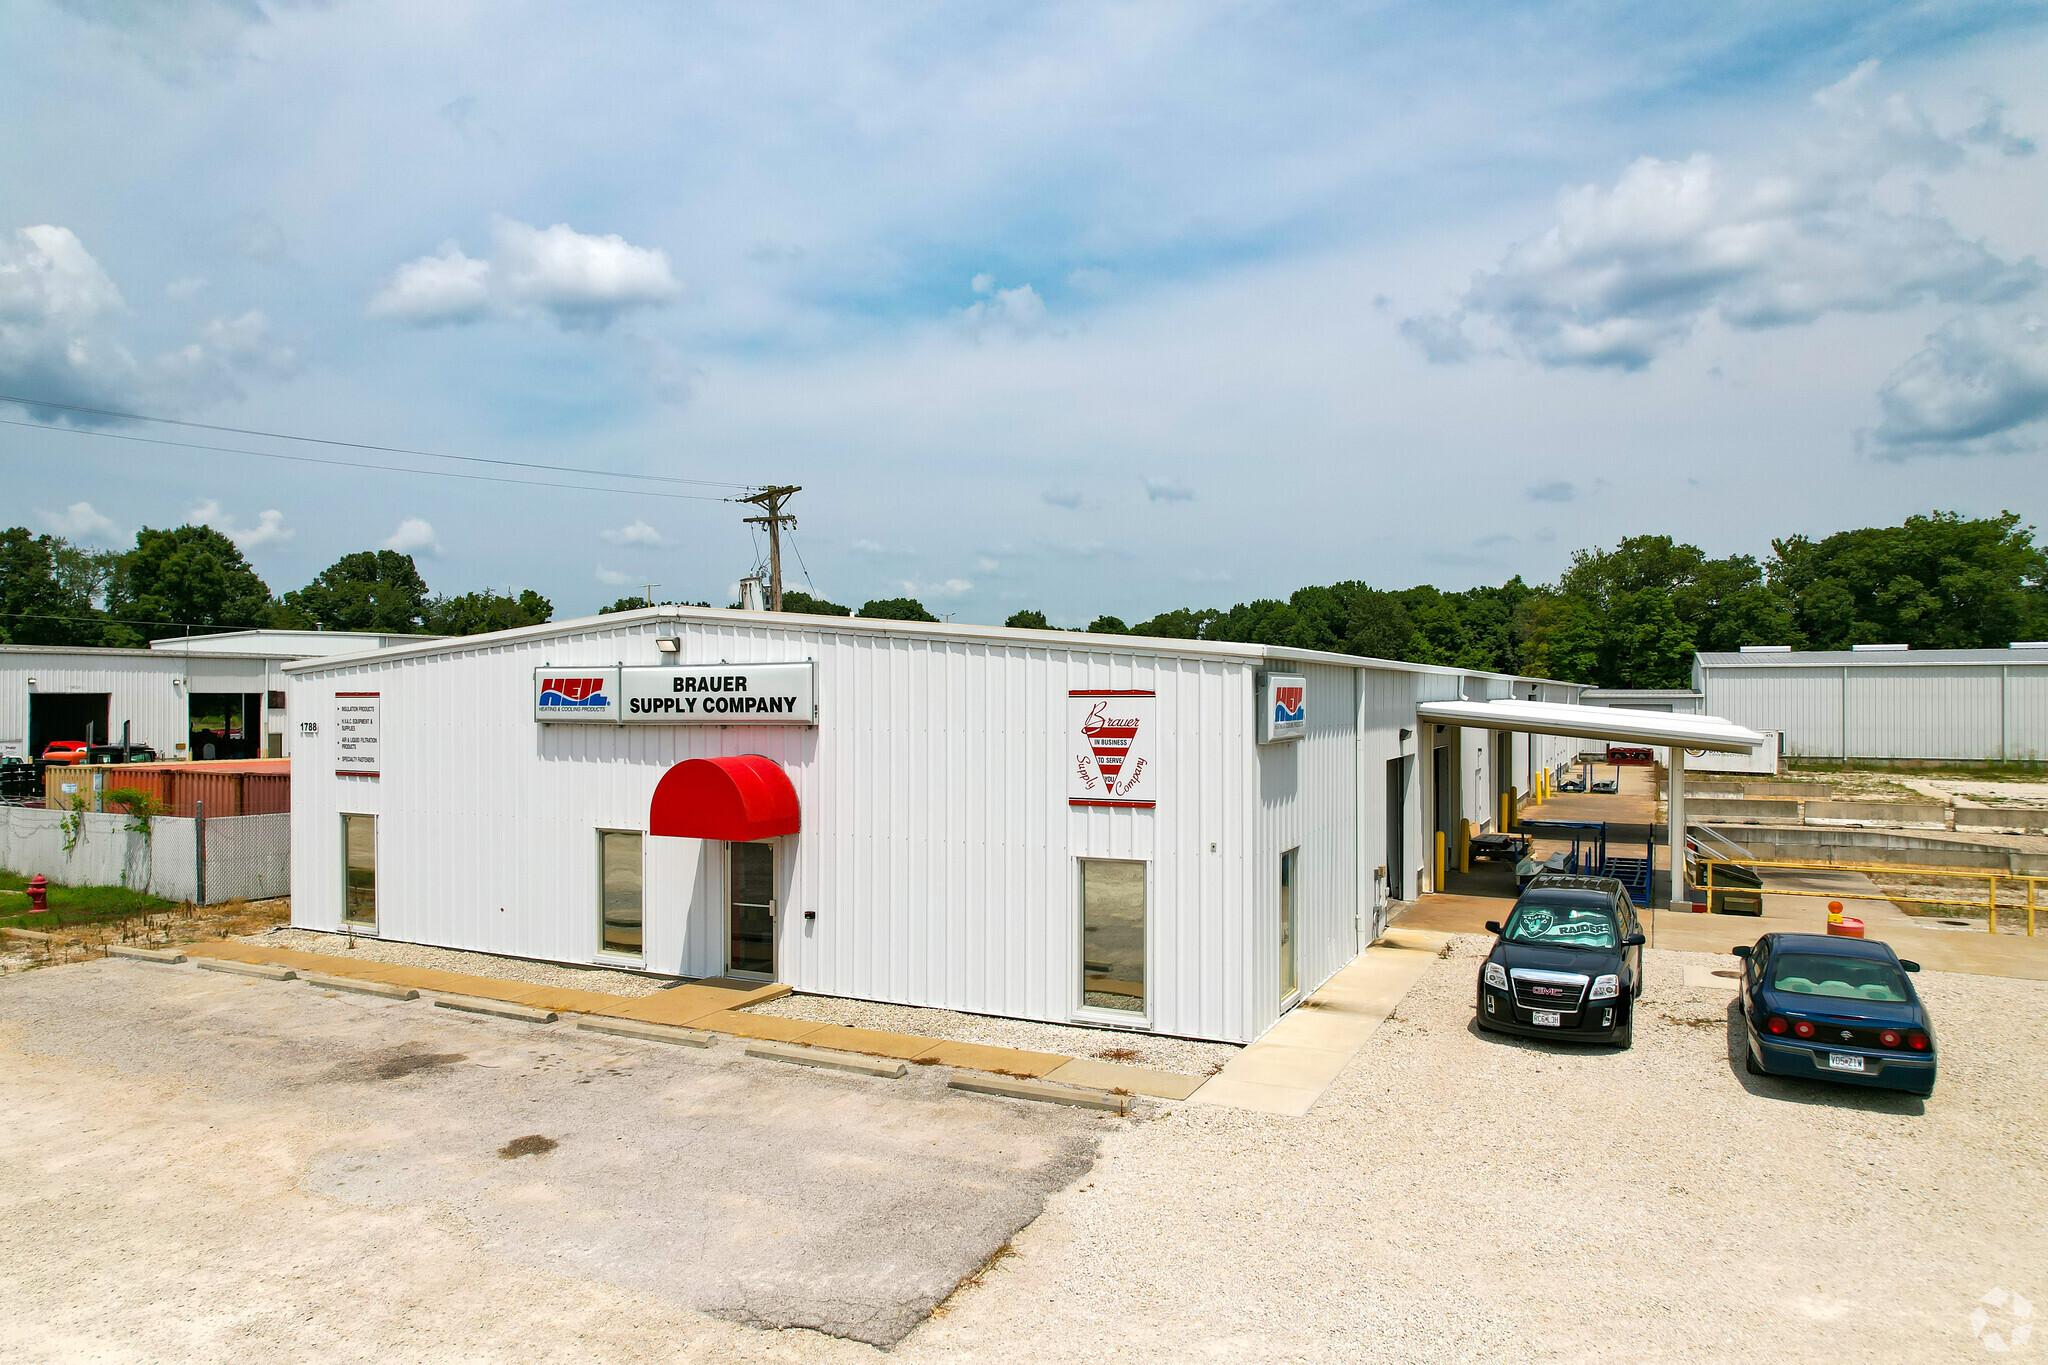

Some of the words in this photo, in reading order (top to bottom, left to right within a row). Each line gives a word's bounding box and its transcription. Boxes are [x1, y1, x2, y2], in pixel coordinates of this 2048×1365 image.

[539, 678, 608, 706] HEIL
[673, 676, 747, 692] BRAUER
[630, 698, 697, 713] SUPPLY
[702, 696, 797, 713] COMPANY
[300, 722, 317, 731] 1788
[1081, 701, 1140, 734] Brauer
[1076, 754, 1098, 790] Supply
[1115, 757, 1148, 796] Company
[1532, 986, 1563, 996] GMC
